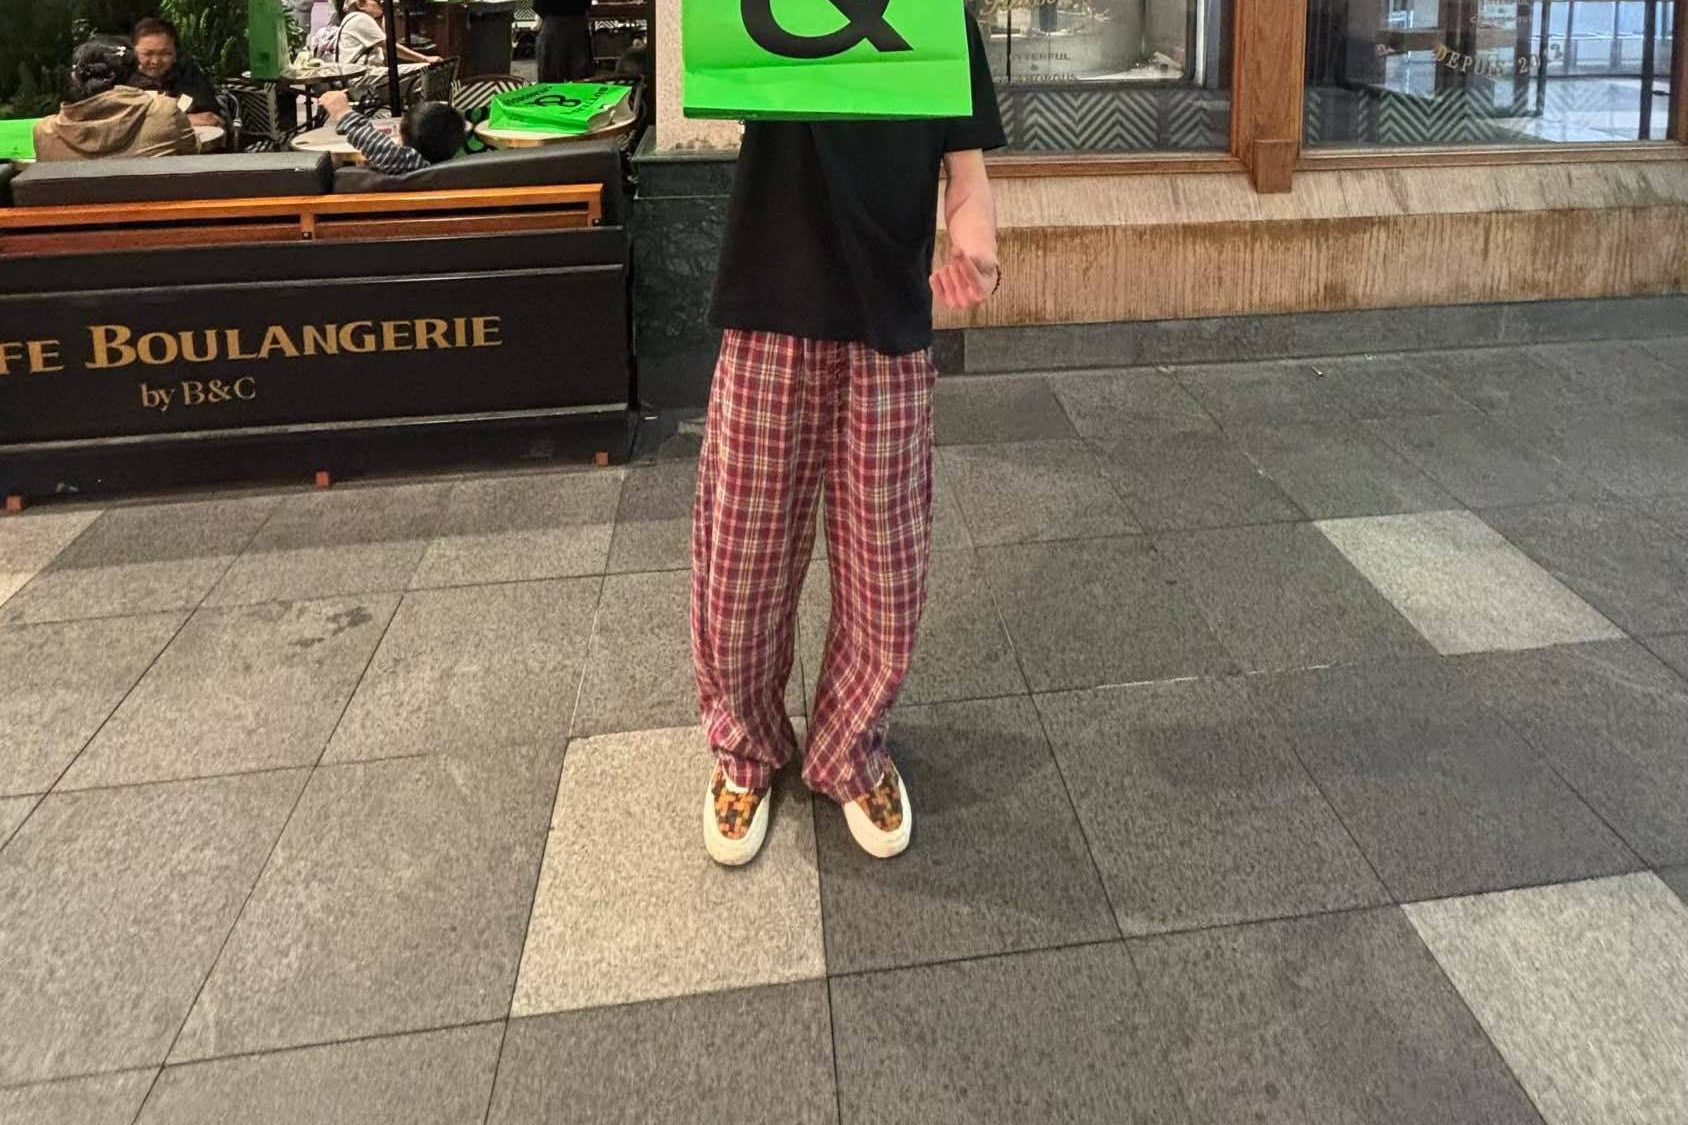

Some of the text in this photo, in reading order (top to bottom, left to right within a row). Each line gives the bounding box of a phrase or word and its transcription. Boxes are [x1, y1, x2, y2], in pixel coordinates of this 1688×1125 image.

[85, 316, 502, 370] BOULANGERIE
[140, 375, 257, 412] by B&C
